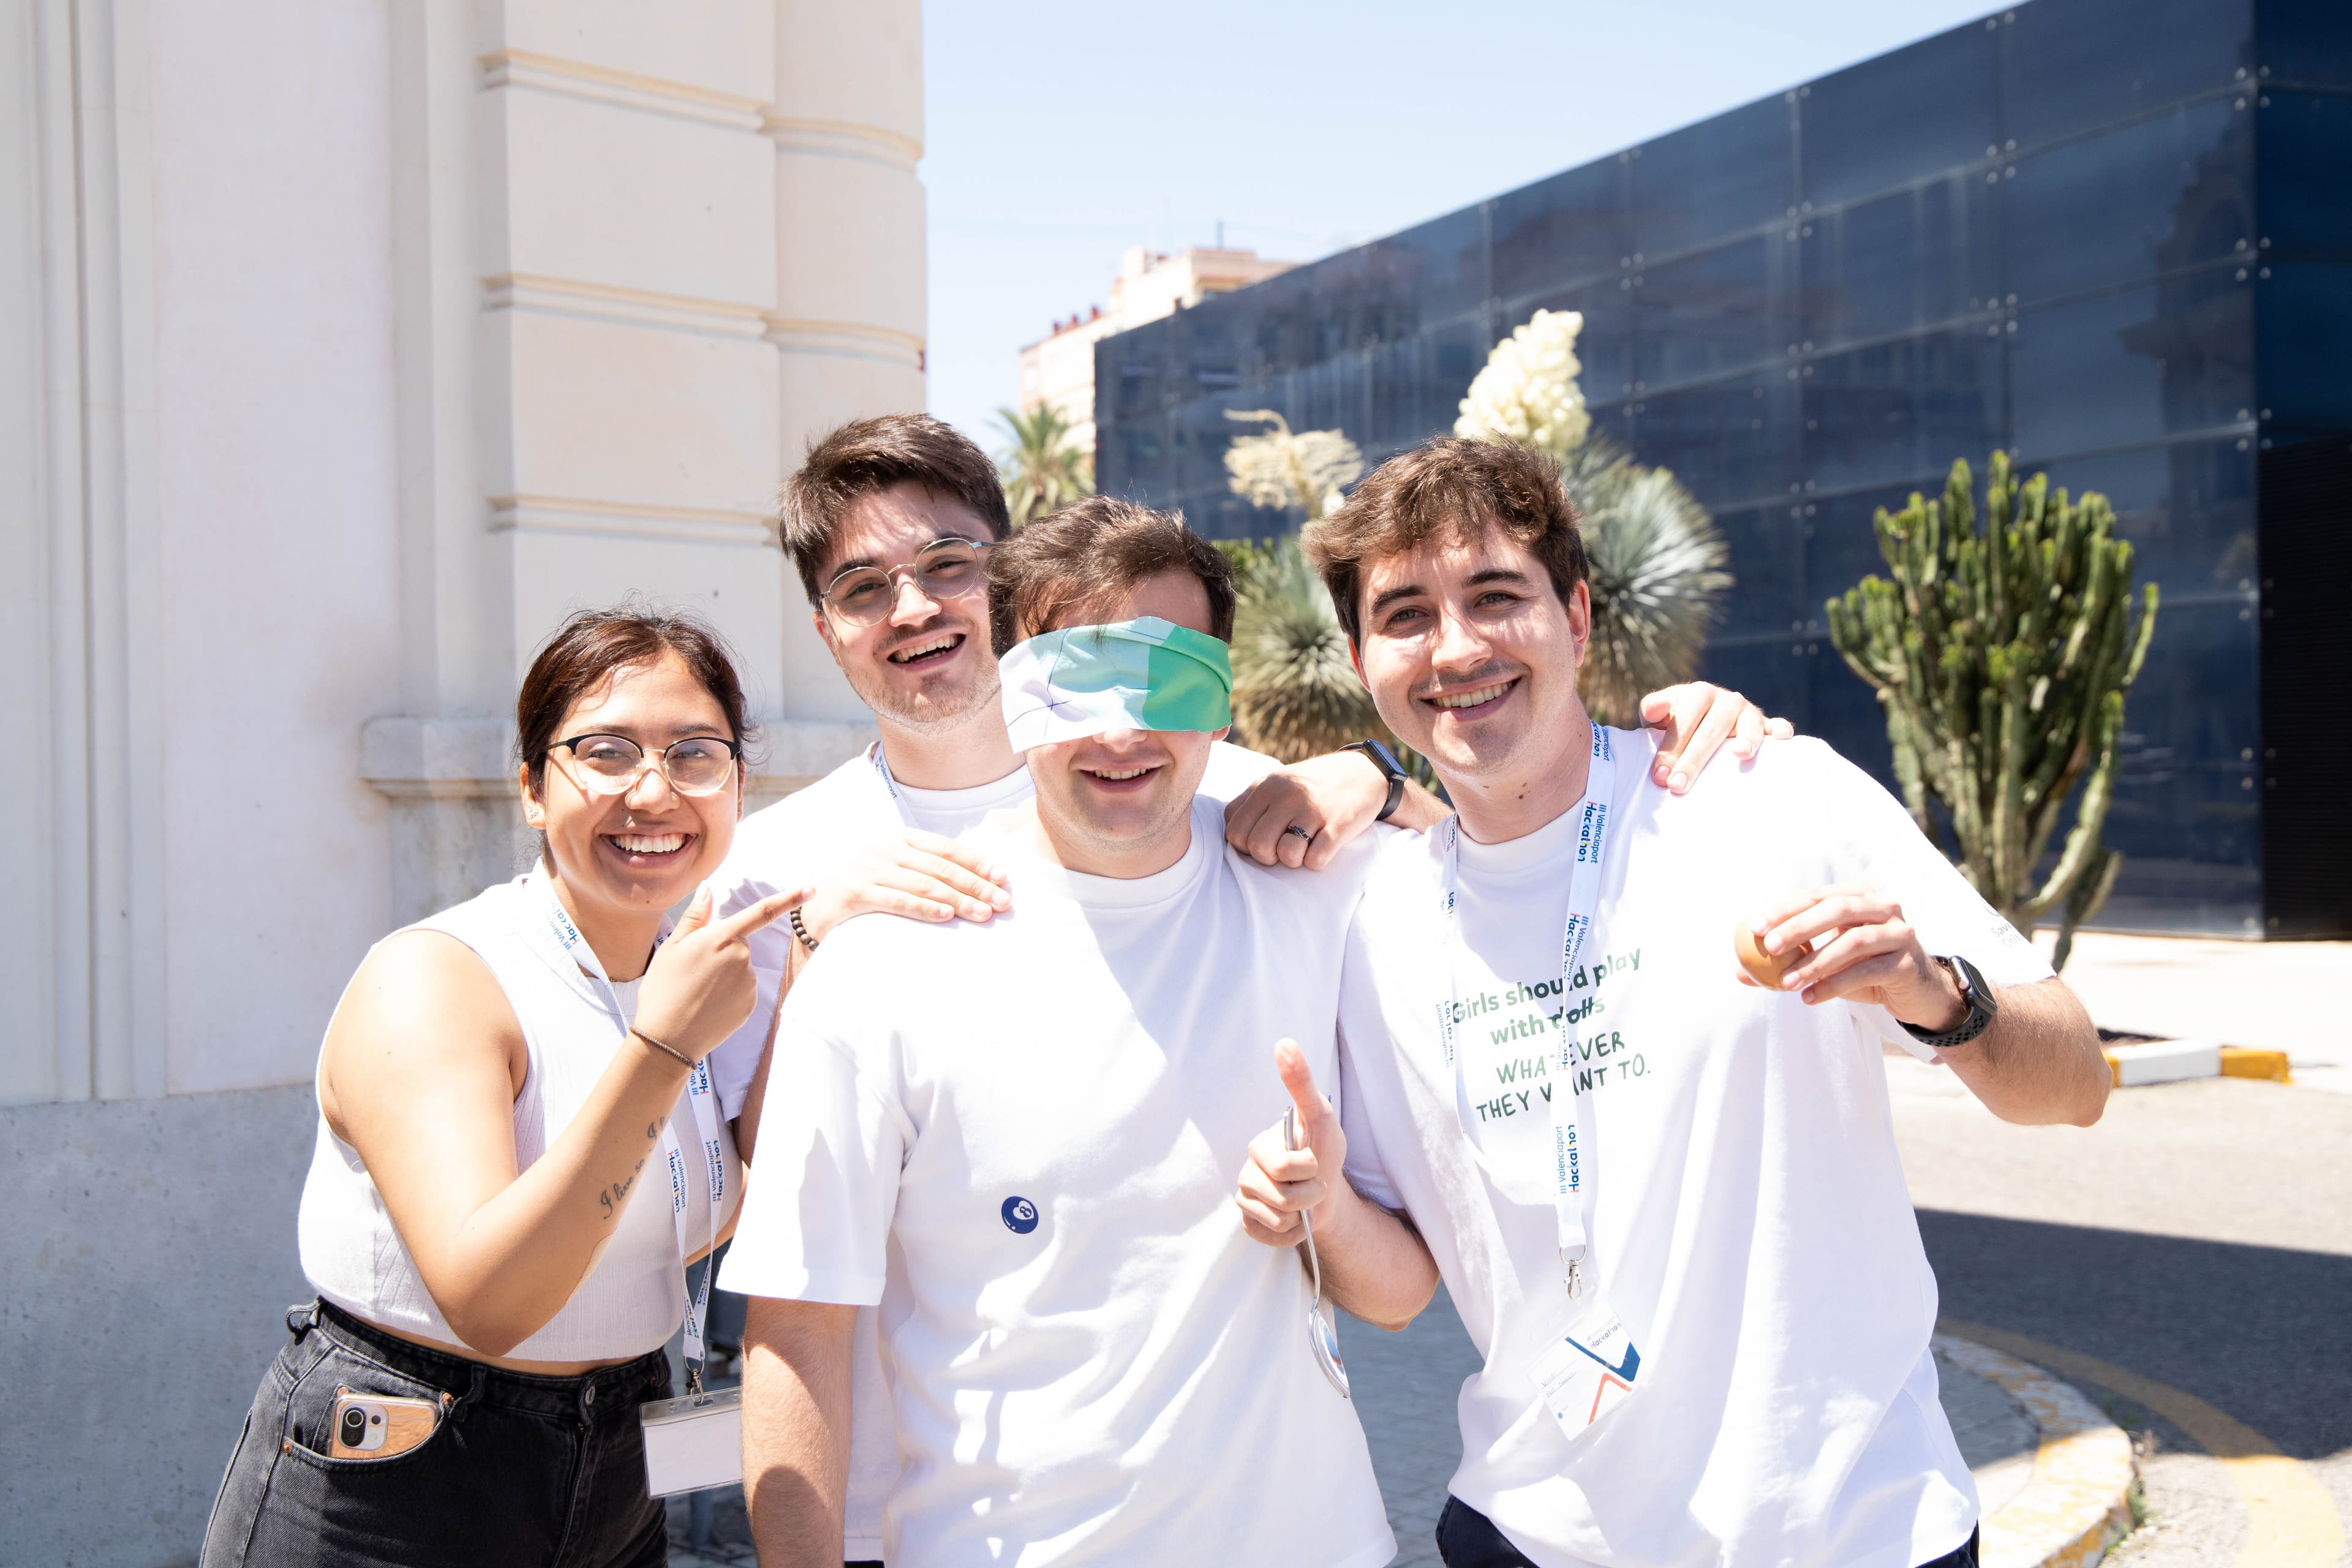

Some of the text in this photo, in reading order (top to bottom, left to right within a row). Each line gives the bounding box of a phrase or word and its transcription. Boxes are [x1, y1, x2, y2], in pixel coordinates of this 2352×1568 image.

[1577, 801, 1597, 862] Hackathon
[1591, 814, 1606, 864] Valenciaport
[1567, 916, 1589, 981] III Valenciaport
[1452, 948, 1640, 1023] Girls shoud play
[1490, 1014, 1545, 1045] with
[1496, 1031, 1625, 1084] WHAVER
[1477, 1090, 1529, 1121] THEY
[1618, 1054, 1651, 1079] TO.
[668, 1151, 680, 1213] Hackathon
[677, 1158, 686, 1208] Valenciaport
[706, 1141, 717, 1191] Valenciaport
[714, 1140, 723, 1201] Hackathon
[1556, 1125, 1567, 1194] III Valenciaport
[1566, 1125, 1580, 1193] Hackathon
